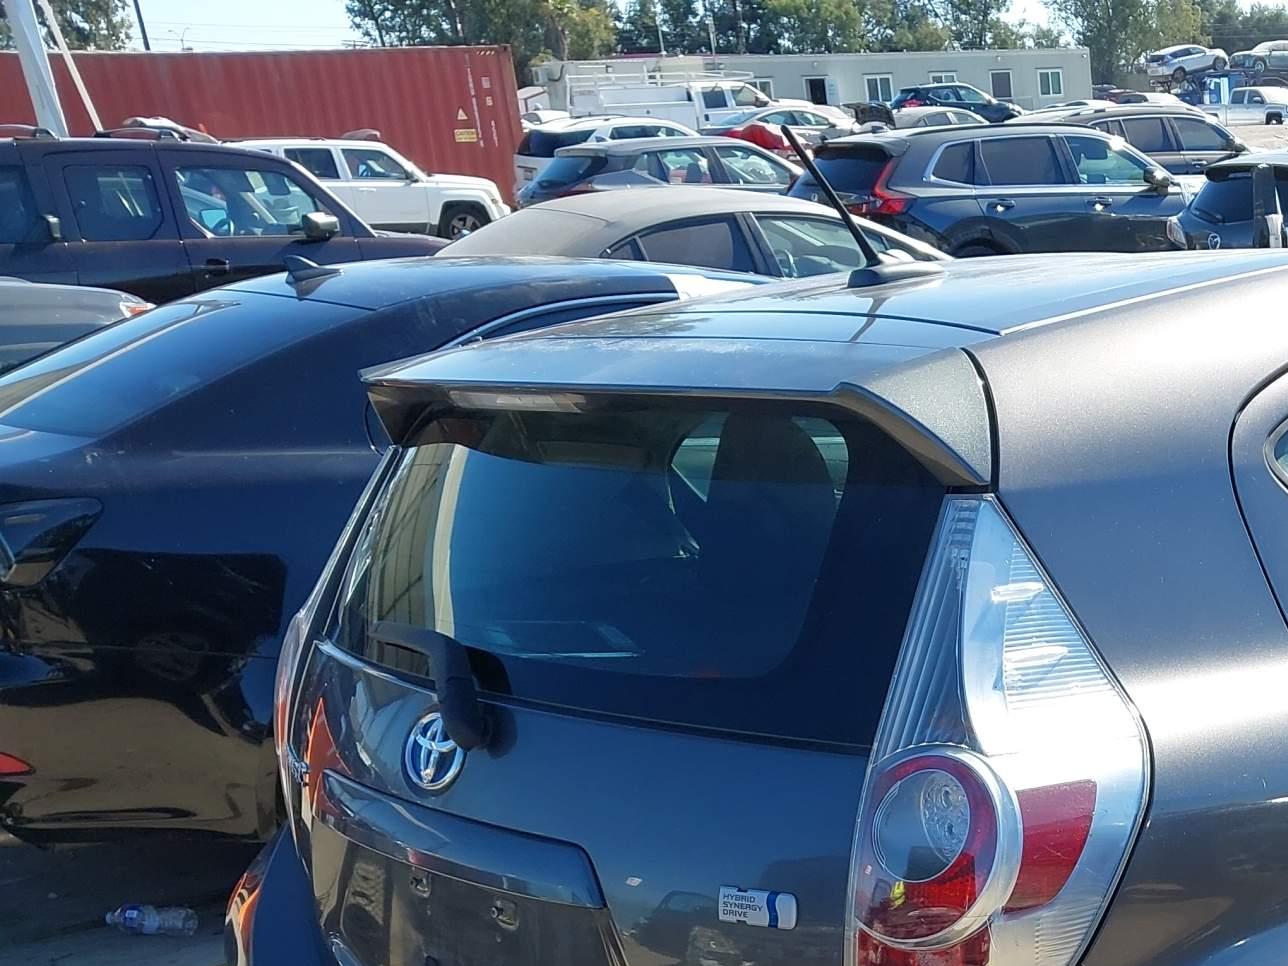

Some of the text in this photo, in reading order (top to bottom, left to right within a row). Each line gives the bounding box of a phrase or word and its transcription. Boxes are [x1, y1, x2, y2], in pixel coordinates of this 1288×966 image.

[723, 893, 756, 904] HYBRID
[722, 901, 763, 912] SYNERGY
[722, 909, 749, 918] DRIVE
